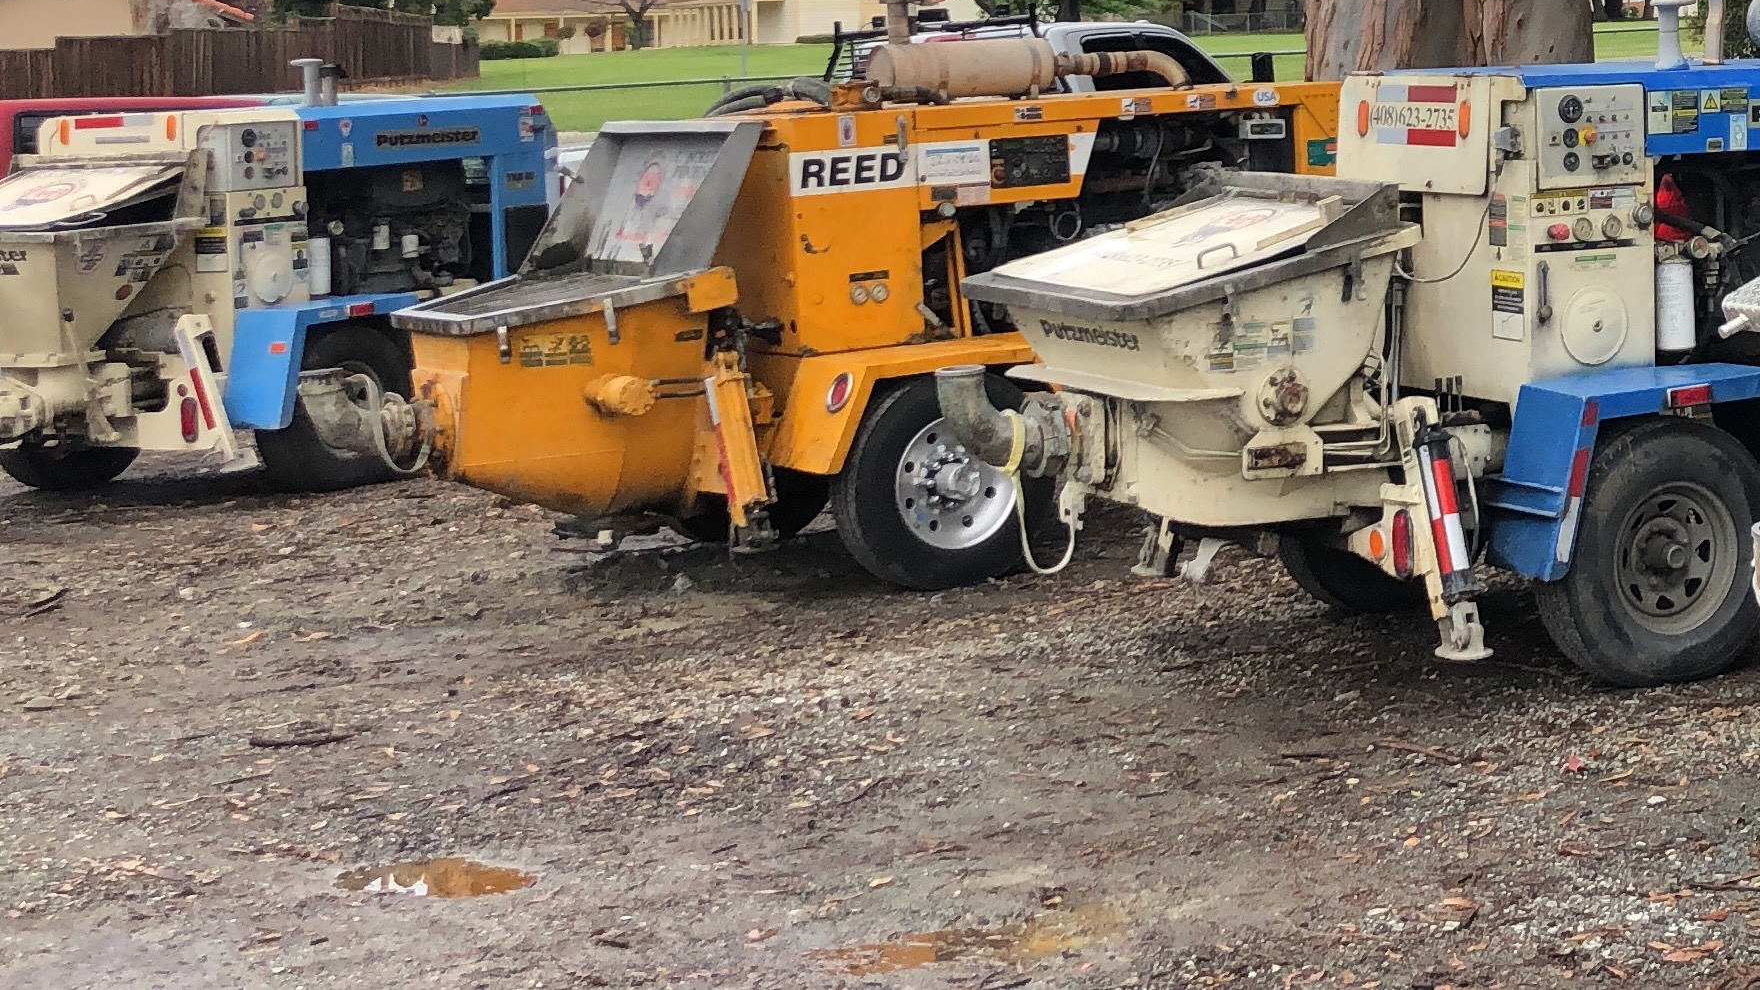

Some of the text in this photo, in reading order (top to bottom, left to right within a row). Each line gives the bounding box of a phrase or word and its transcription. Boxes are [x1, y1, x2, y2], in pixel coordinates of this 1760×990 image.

[1256, 91, 1277, 103] USA
[1370, 105, 1456, 130] (408)623-2735
[376, 130, 479, 147] Putzmeister
[800, 153, 906, 190] REED
